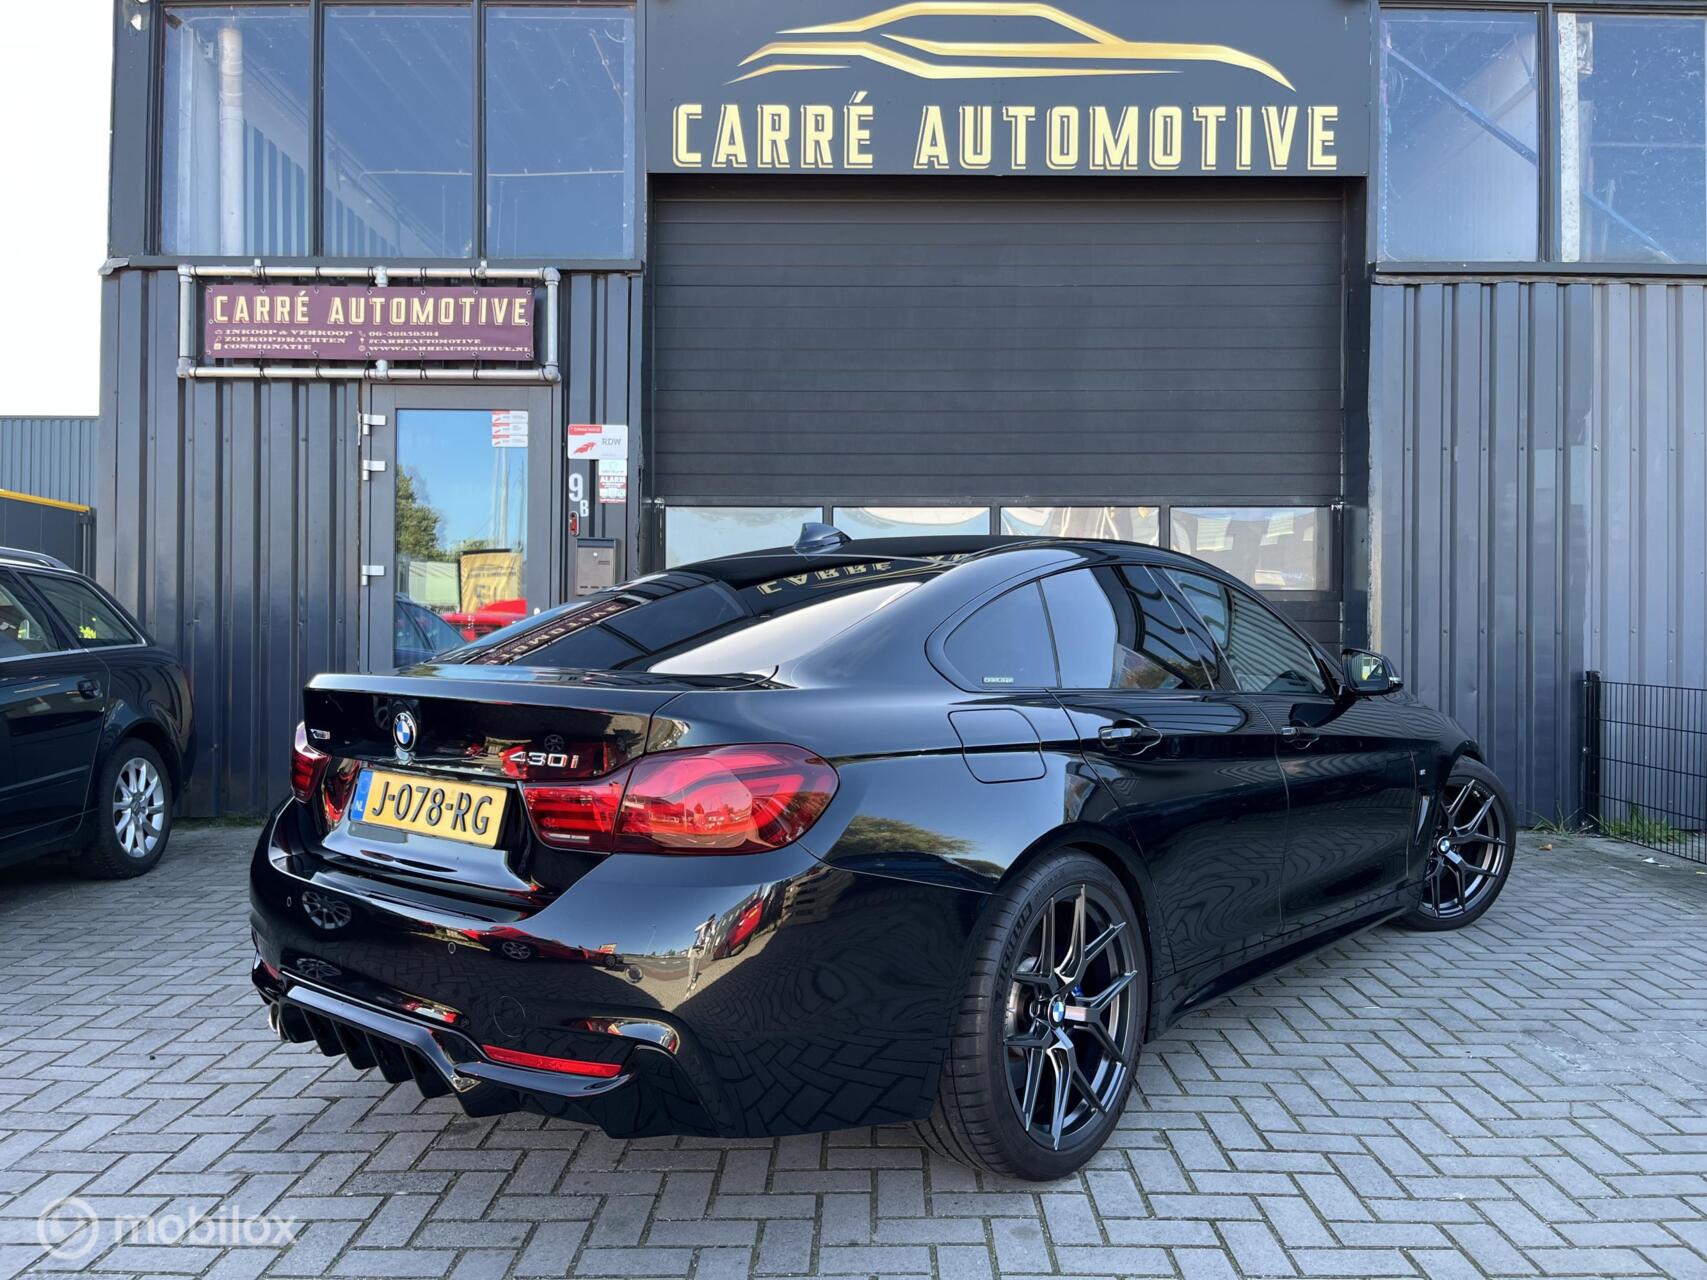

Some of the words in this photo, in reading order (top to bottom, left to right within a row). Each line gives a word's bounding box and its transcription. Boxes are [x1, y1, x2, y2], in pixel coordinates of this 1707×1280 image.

[672, 91, 874, 169] CARRÉ
[913, 105, 1338, 171] AUTOMOTIVE
[213, 290, 310, 325] CARRÉ
[327, 296, 529, 326] AUTOMOTIVE
[224, 336, 347, 344] ZOEKOPDRACHTEN
[602, 438, 622, 446] RDW
[569, 472, 583, 502] 9
[580, 500, 589, 517] B
[509, 751, 579, 770] 430i
[354, 799, 364, 812] NL
[371, 780, 493, 836] J-078-RG
